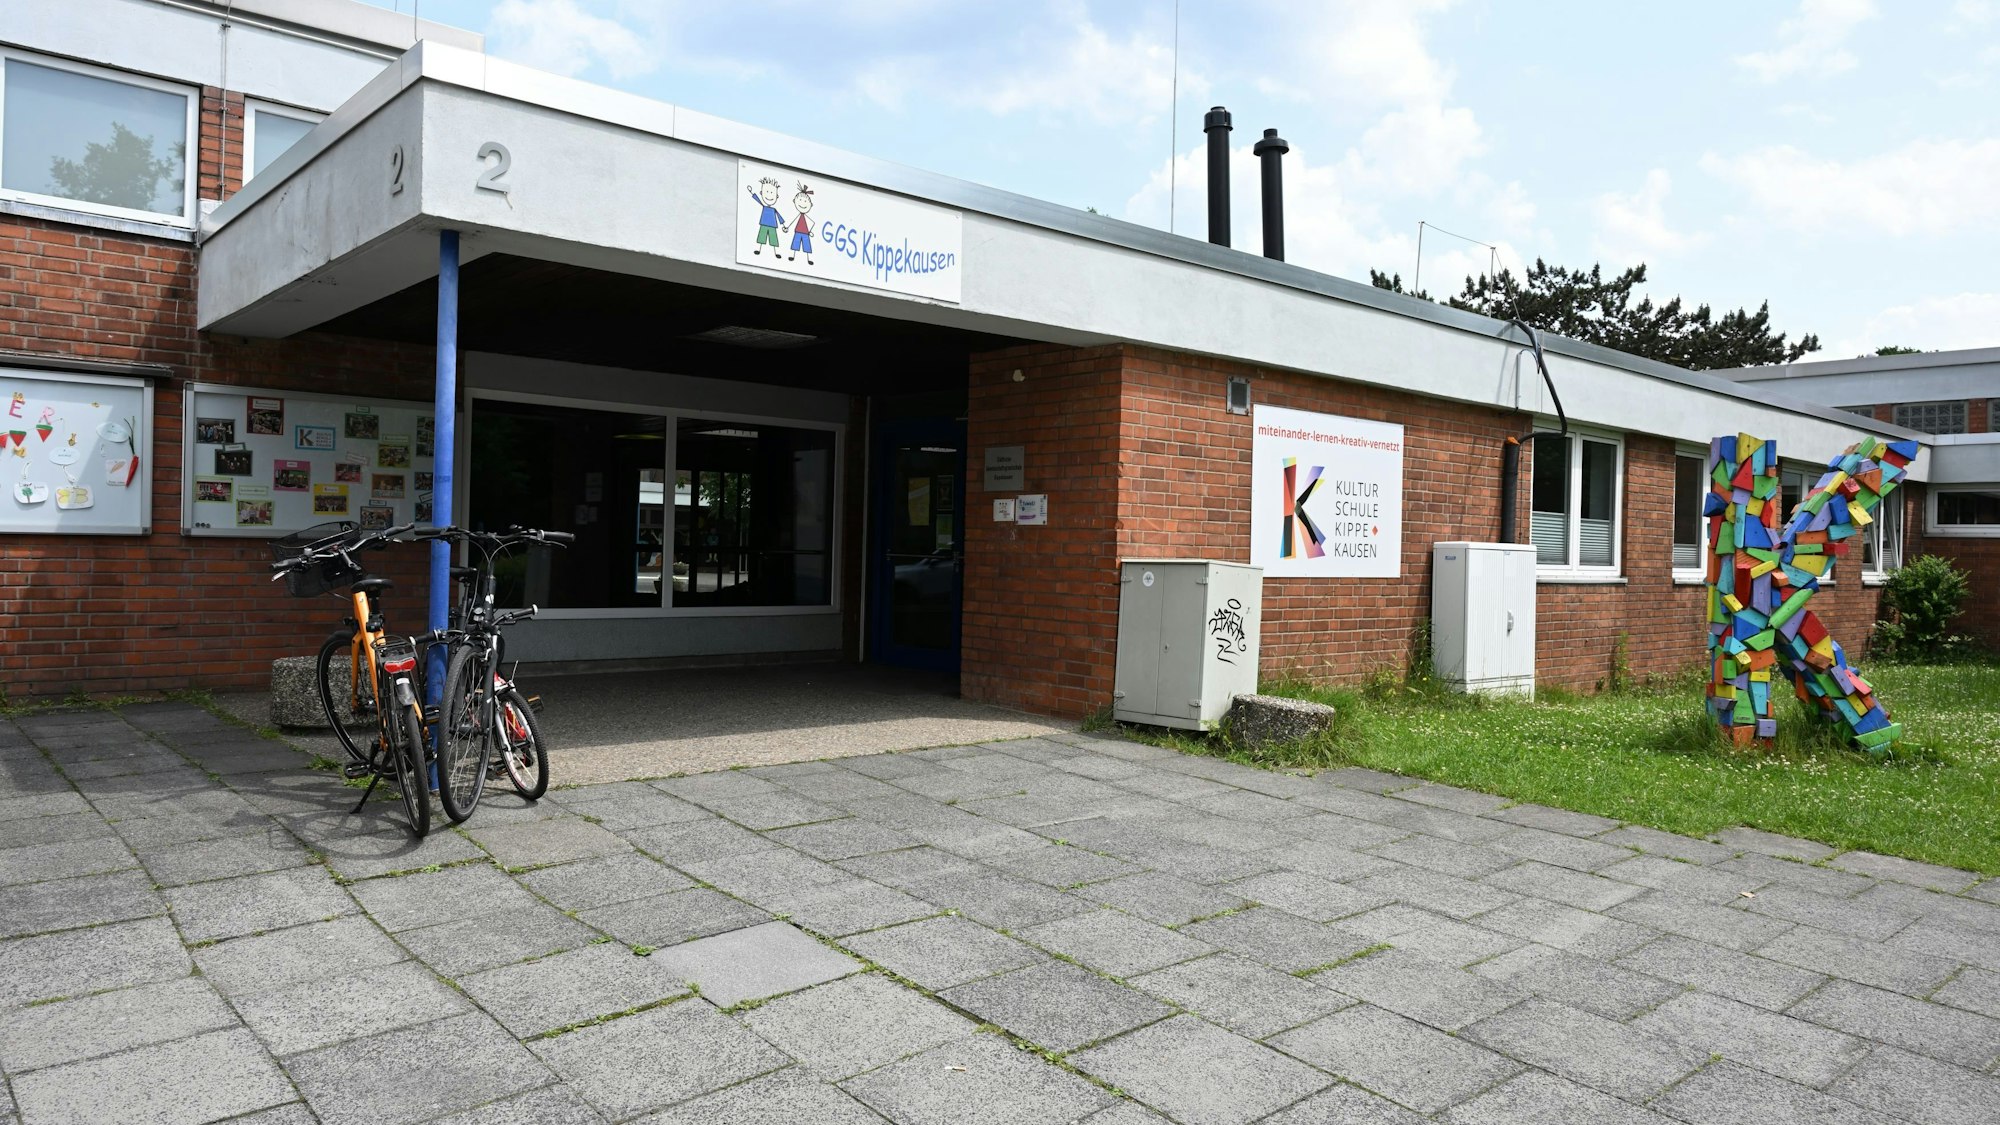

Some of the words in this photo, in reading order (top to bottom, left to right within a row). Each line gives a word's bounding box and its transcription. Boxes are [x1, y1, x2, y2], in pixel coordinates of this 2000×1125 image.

[392, 144, 404, 195] 2
[476, 141, 513, 194] 2
[821, 220, 858, 258] GGS
[861, 229, 956, 281] Kippekausen
[1258, 425, 1400, 451] miteinander-lernen-kreativ-vernetzt
[1336, 480, 1379, 498] KULTUR
[1335, 500, 1379, 518] SCHULE
[1335, 522, 1369, 538] KIPPE
[1334, 543, 1377, 558] KAUSEN
